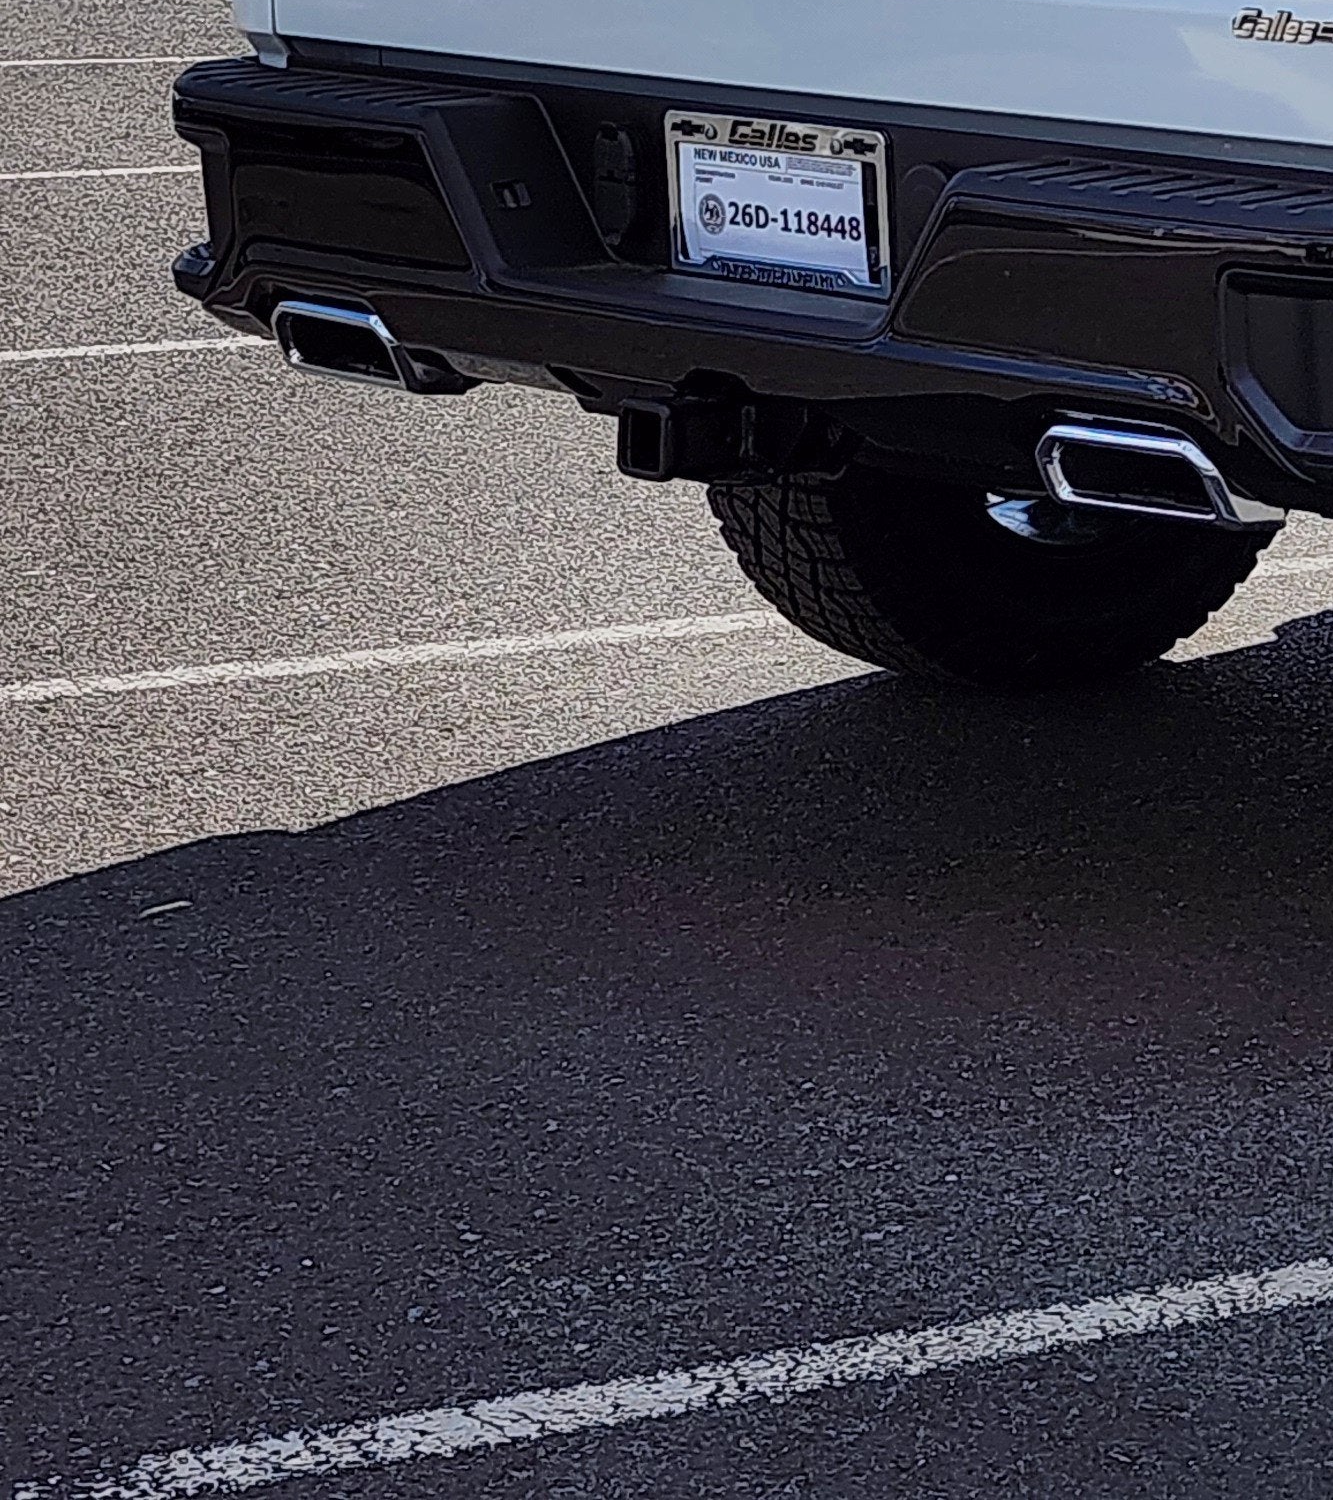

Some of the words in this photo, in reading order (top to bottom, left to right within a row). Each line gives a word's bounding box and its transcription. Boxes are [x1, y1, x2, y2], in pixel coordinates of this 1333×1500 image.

[1232, 7, 1317, 44] Galles
[728, 120, 819, 151] Galles
[694, 148, 717, 162] NEW
[719, 150, 757, 167] MEXICO
[759, 155, 781, 170] USA
[728, 201, 862, 241] 26D-118448
